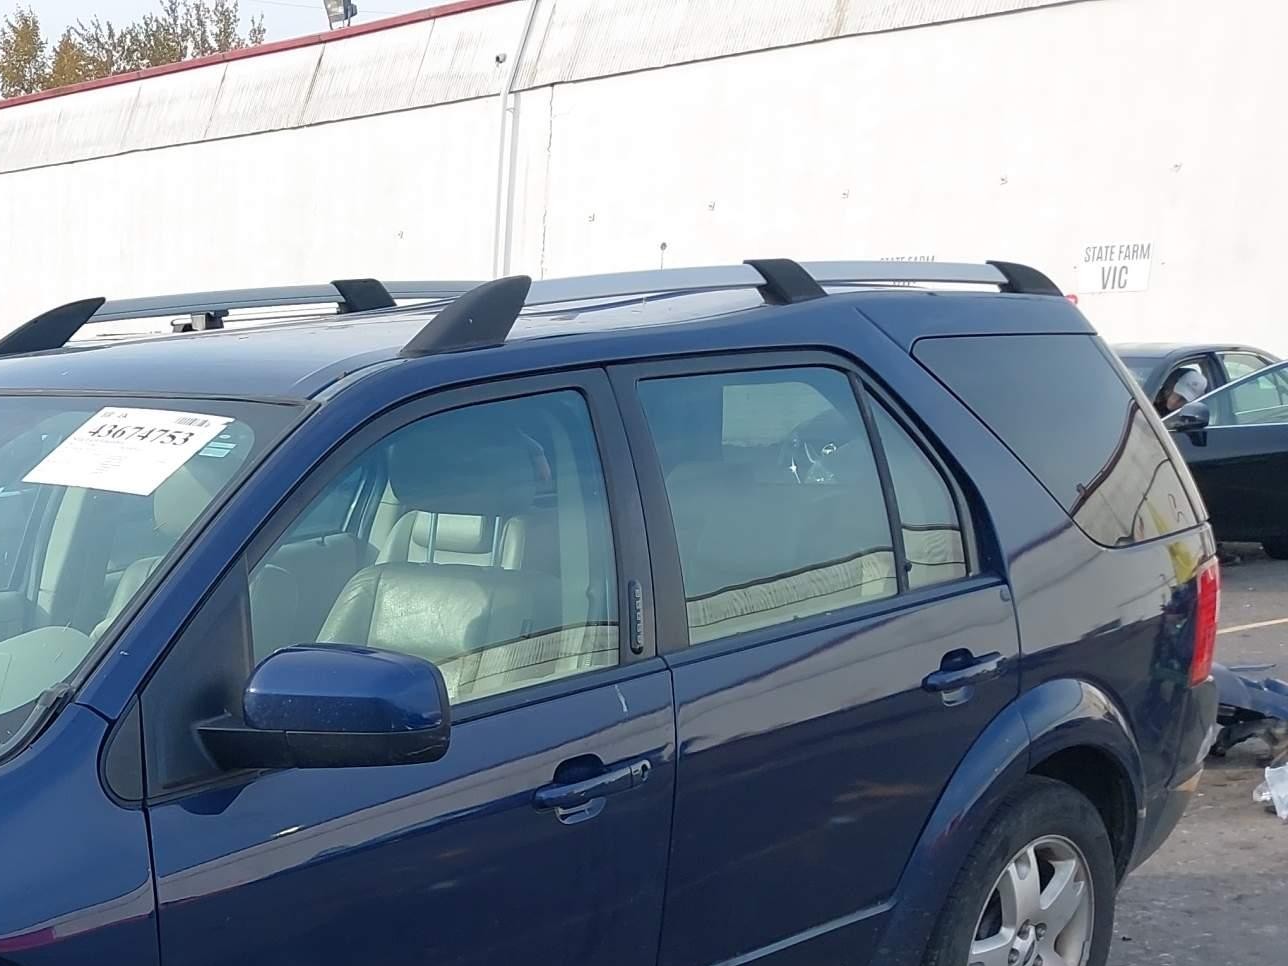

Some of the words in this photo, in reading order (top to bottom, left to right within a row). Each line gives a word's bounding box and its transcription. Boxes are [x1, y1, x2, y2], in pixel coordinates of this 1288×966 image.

[1084, 245, 1116, 263] STATE
[1118, 243, 1151, 261] FARM
[1101, 265, 1128, 290] VIC
[88, 423, 195, 446] 43674753
